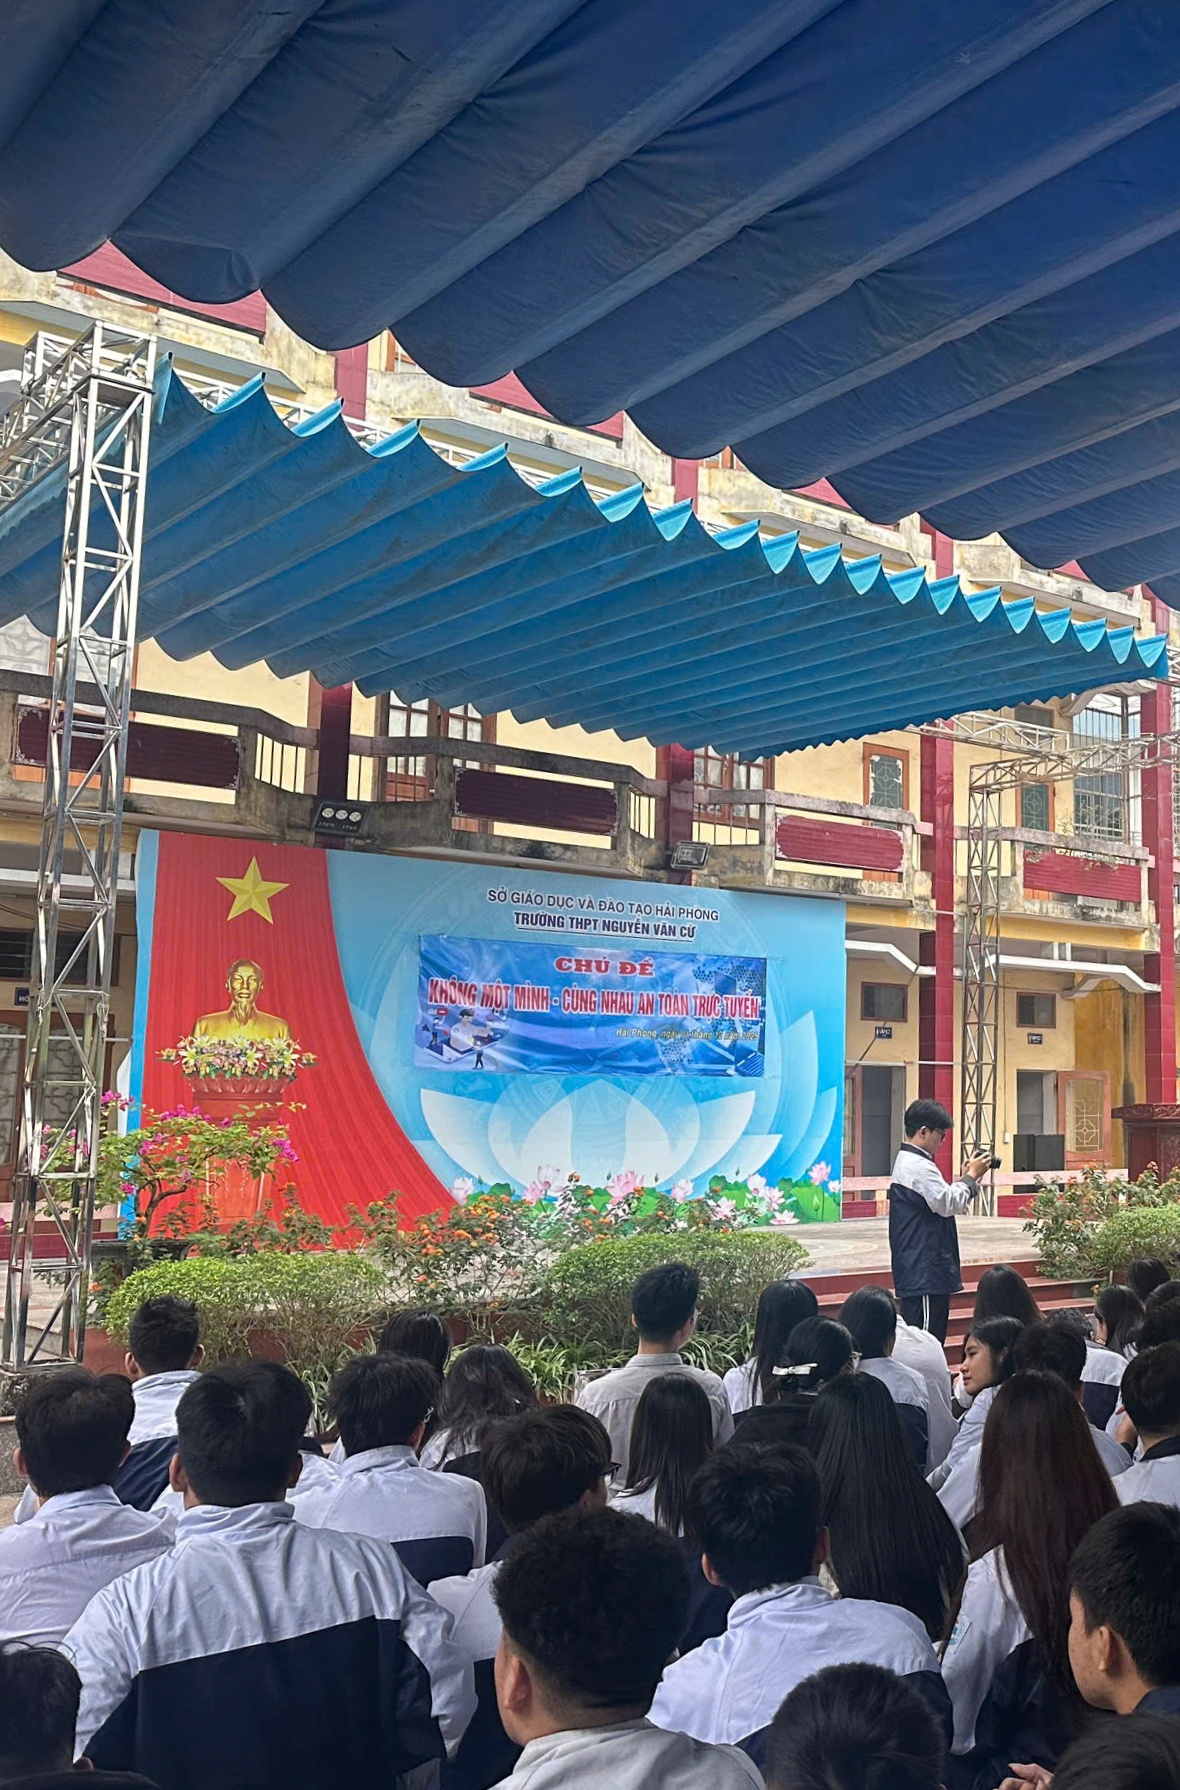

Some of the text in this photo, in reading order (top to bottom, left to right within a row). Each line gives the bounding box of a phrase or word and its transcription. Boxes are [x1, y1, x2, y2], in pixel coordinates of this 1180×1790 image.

[488, 886, 719, 921] SỞ GIÁO DỤC VÀ ĐÀO TẠO HẢI PHÒNG
[514, 911, 696, 938] TRƯỜNG THPT NGUYỄN VĂN CỪ
[555, 956, 654, 976] CHỦ ĐỀ
[428, 975, 478, 1007] KHÔNG
[480, 979, 511, 1015] MỘT
[513, 981, 550, 1012] MÌNH
[562, 983, 597, 1014] CÙNG
[600, 990, 634, 1015] NHAU
[637, 992, 655, 1016] AN
[658, 989, 689, 1017] TOÀN
[692, 993, 721, 1022] TRỰC
[722, 990, 760, 1018] TUYẾN
